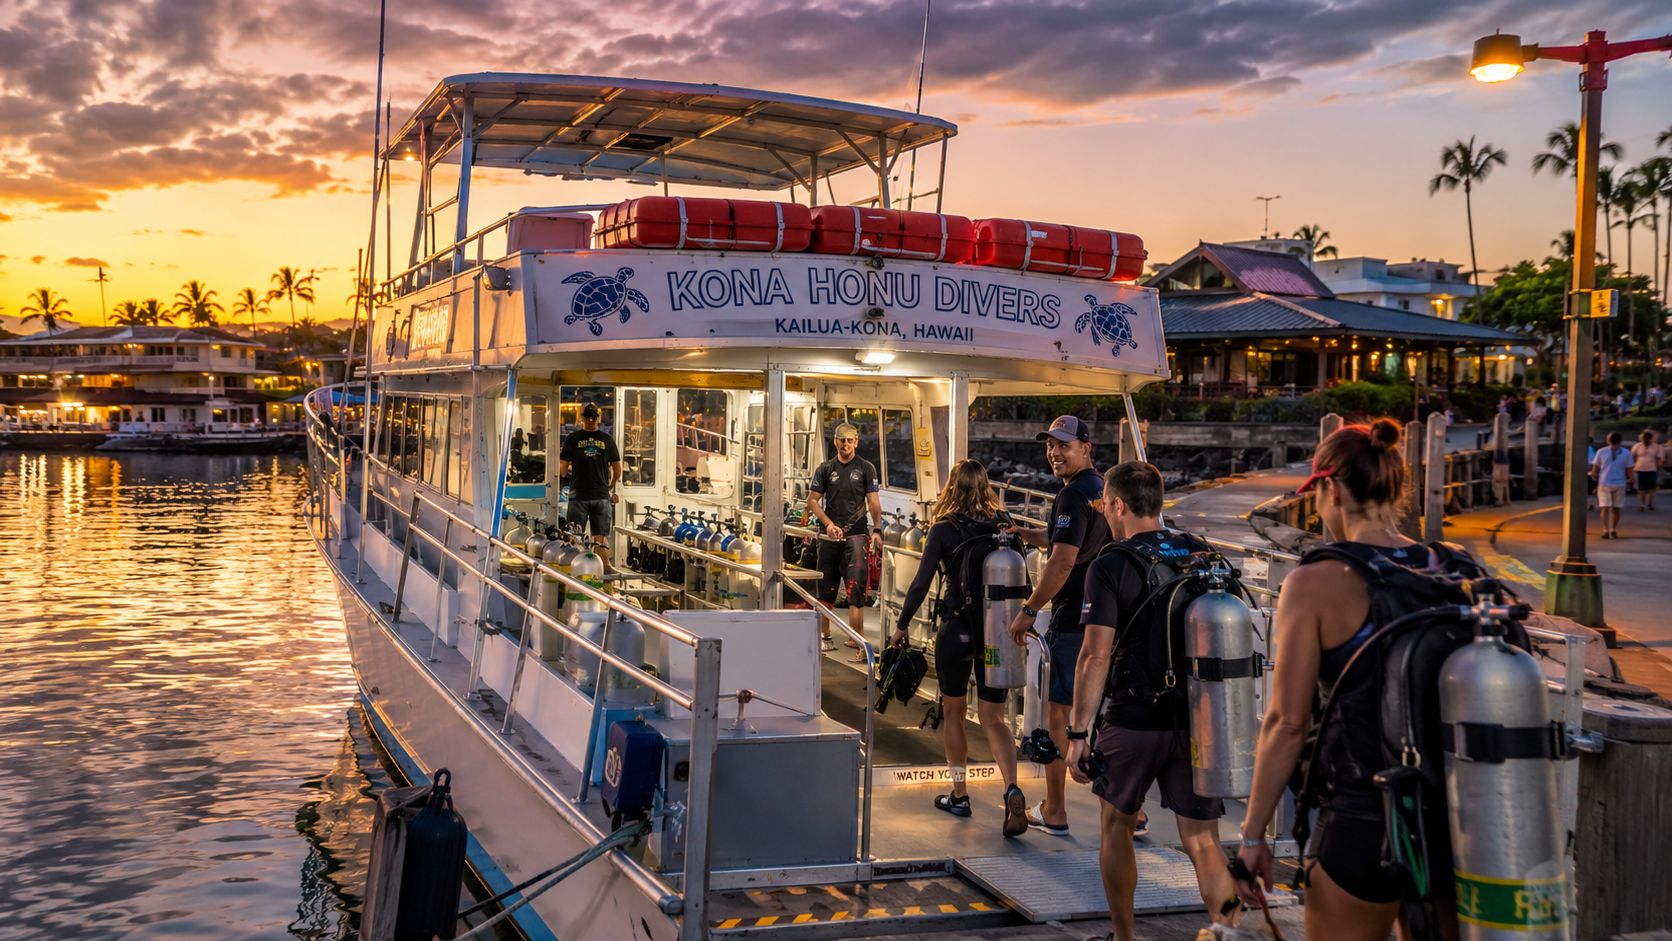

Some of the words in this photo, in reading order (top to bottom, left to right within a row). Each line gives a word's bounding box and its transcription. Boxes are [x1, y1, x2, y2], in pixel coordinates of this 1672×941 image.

[667, 268, 794, 311] KONA
[808, 267, 920, 309] HONU
[935, 275, 1061, 329] DIVERS
[775, 318, 906, 339] KAILUA-KONA,
[914, 323, 974, 342] HAWAII
[896, 770, 934, 781] WATCH
[969, 768, 995, 778] STEP
